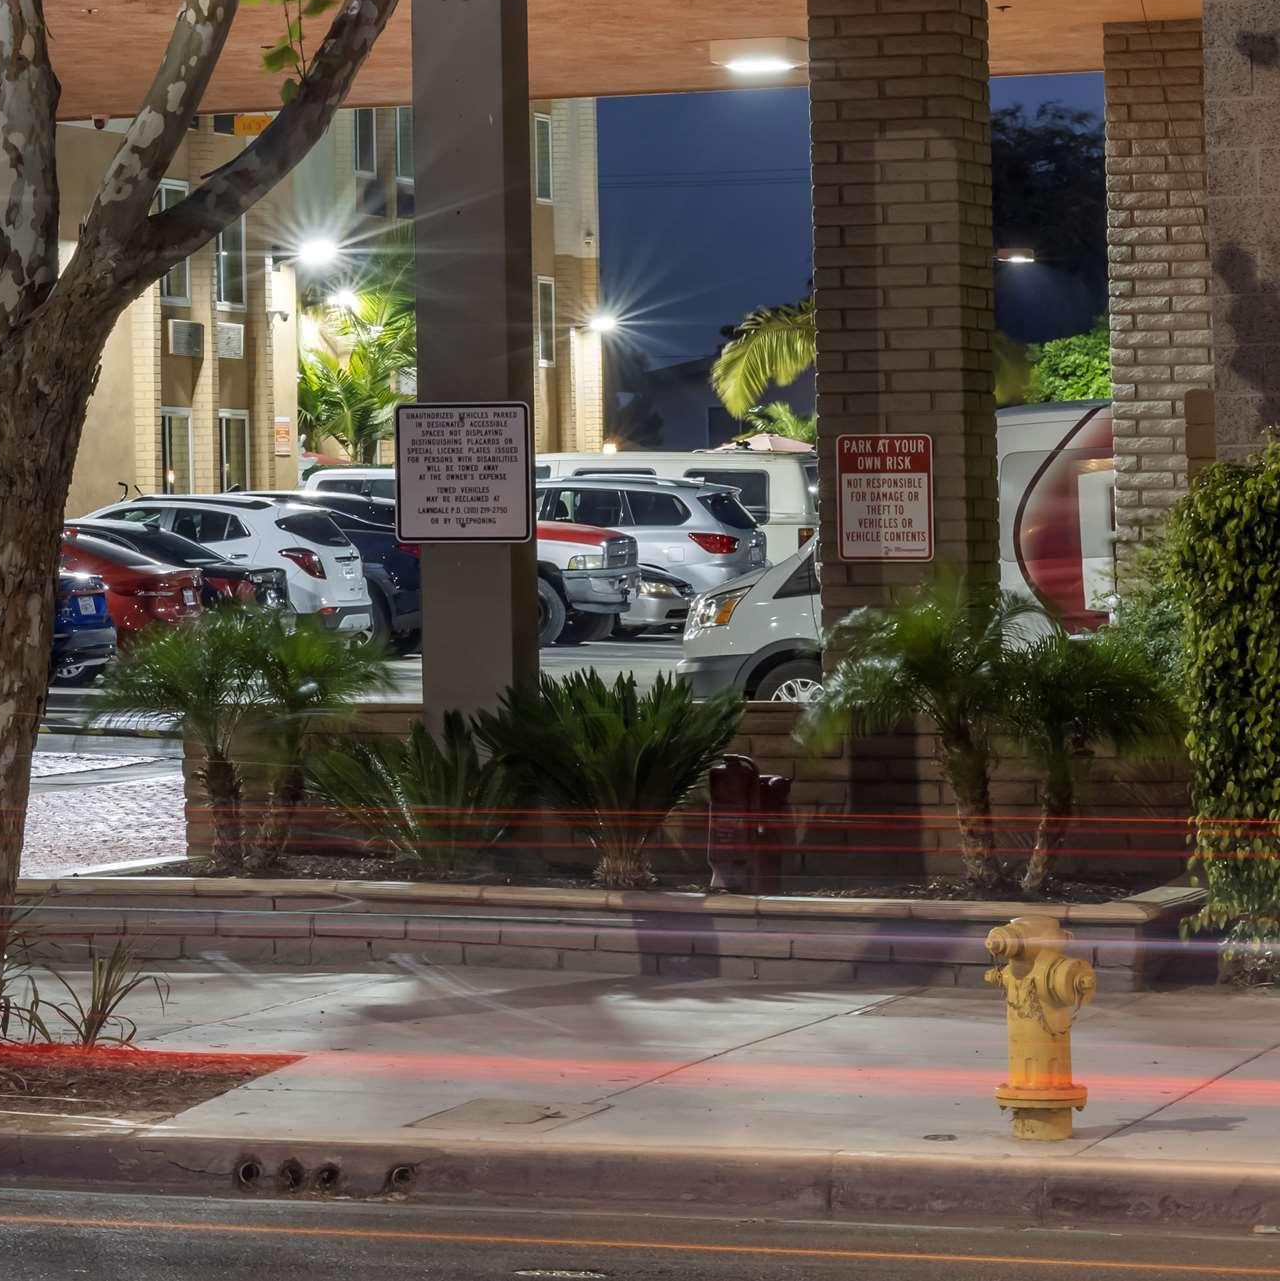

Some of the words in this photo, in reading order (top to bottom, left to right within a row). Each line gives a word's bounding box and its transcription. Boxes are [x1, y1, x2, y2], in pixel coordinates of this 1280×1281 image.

[844, 440, 872, 454] PARK
[877, 439, 890, 453] AT
[894, 439, 925, 453] YOUR
[857, 457, 881, 470] OWN
[886, 456, 912, 470] RISK
[847, 478, 862, 488] NOT
[866, 478, 922, 488] RESPONSIBLE
[850, 491, 867, 502] FOR
[870, 491, 904, 502] DAMAGE
[907, 491, 920, 502] OR
[866, 505, 891, 515] THEFT
[894, 505, 904, 515] TO
[858, 519, 898, 529] VEHICLES
[901, 519, 913, 529] OR
[846, 532, 881, 542] VEHICLE
[884, 532, 927, 542] CONTENTS
